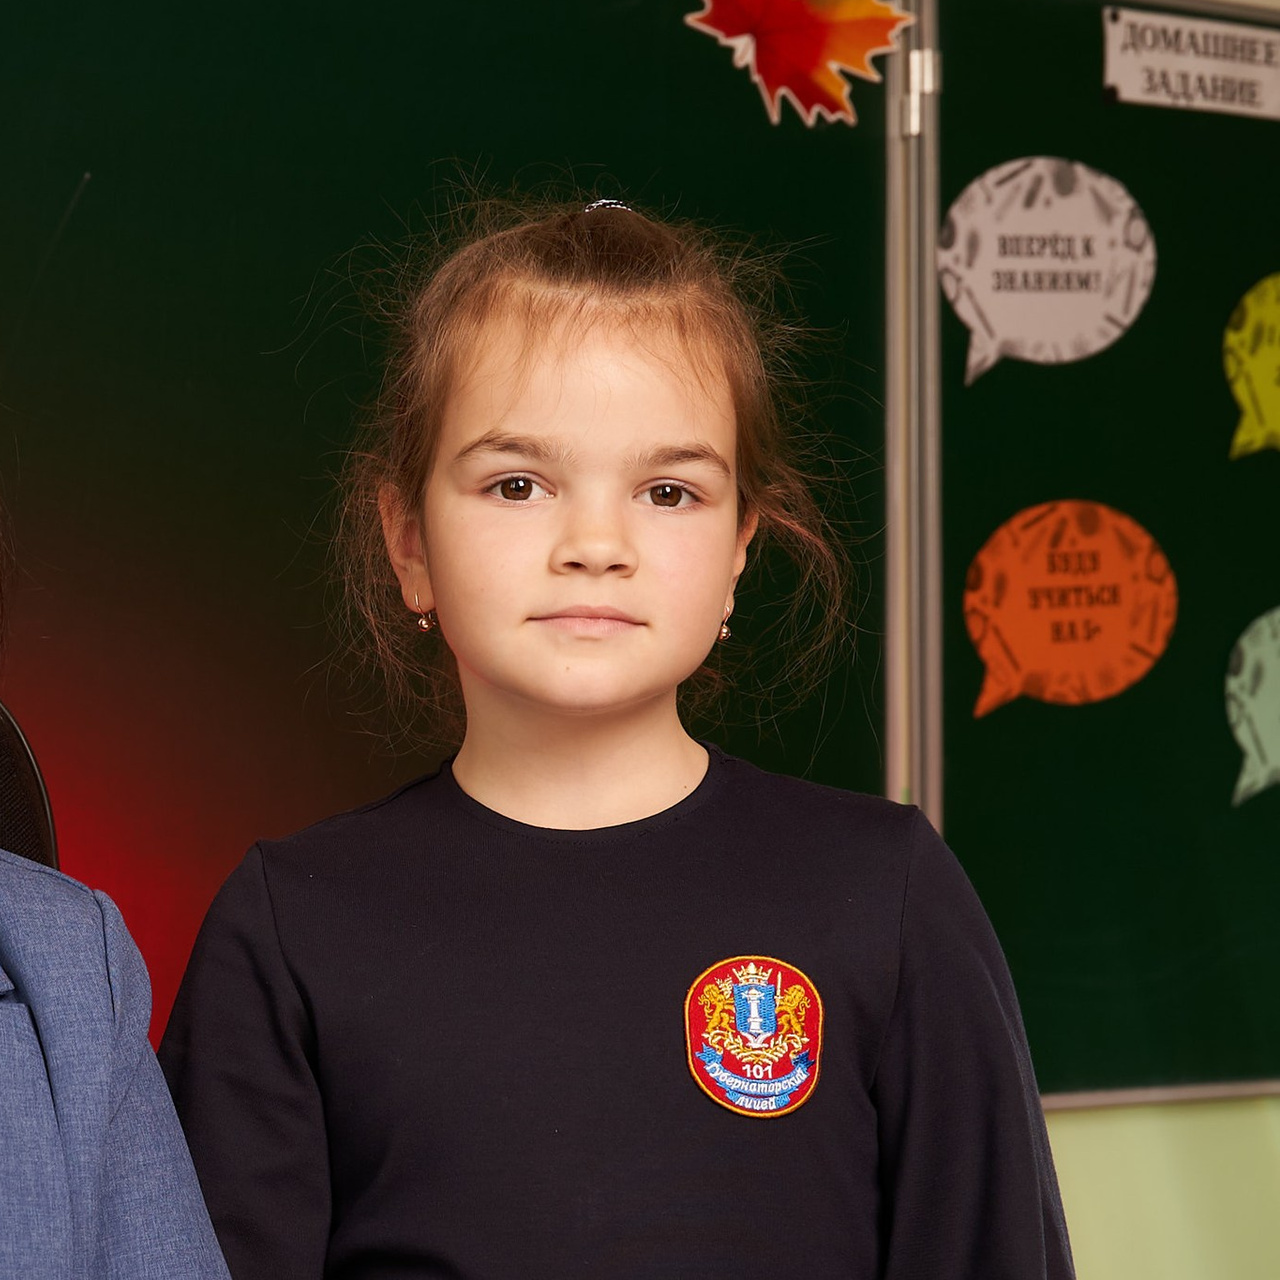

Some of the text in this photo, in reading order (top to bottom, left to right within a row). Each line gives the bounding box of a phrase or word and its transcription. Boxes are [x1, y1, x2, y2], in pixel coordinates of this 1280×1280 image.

[1122, 22, 1279, 68] ДОМАШНЕЕ
[1142, 66, 1263, 107] ЗАДАНИЕ
[998, 232, 1095, 261] ВПЕРЁД К
[992, 269, 1102, 292] ЗНАНИЯМ!
[1028, 584, 1121, 609] УЧИТЬСЯ
[1051, 620, 1079, 643] НА
[705, 1062, 808, 1094] Губернаторский
[742, 1064, 773, 1079] 101
